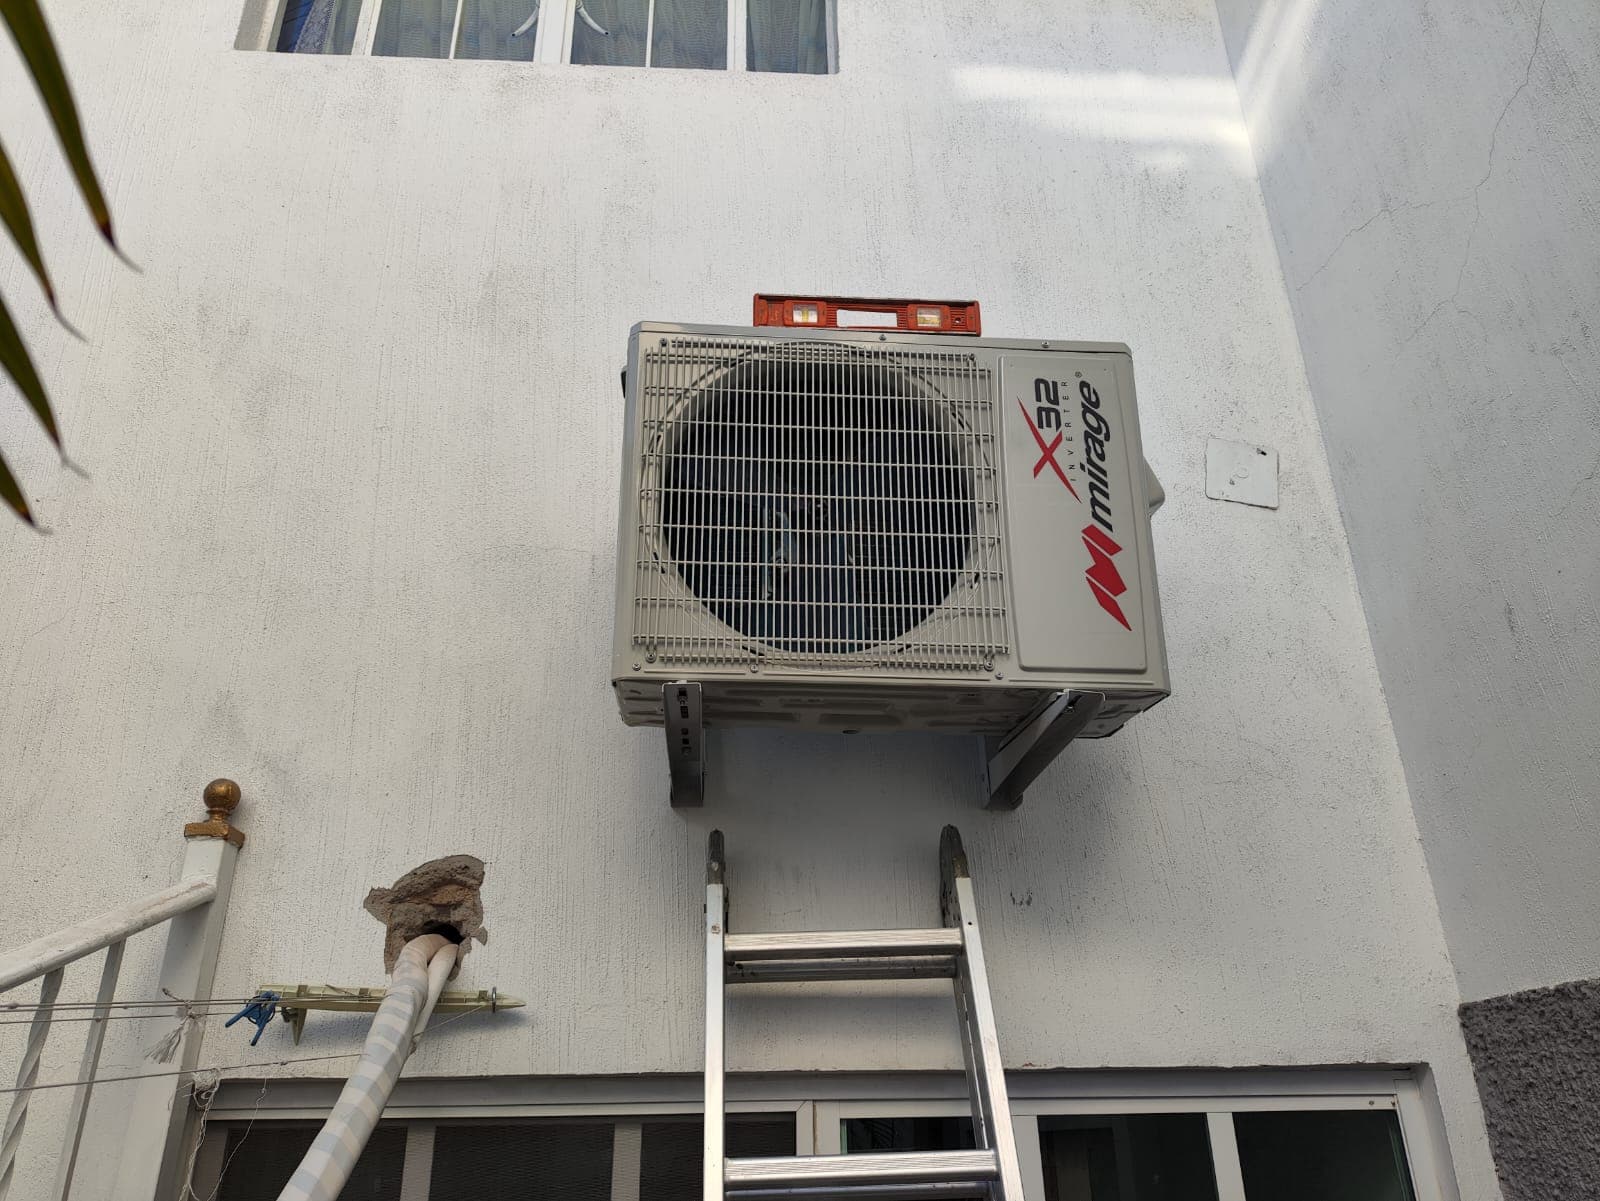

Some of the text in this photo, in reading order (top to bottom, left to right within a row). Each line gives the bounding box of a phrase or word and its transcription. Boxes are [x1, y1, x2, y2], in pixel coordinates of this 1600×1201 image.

[1017, 378, 1082, 504] X32
[1061, 381, 1077, 482] INVERTER
[1079, 380, 1114, 532] mirage
